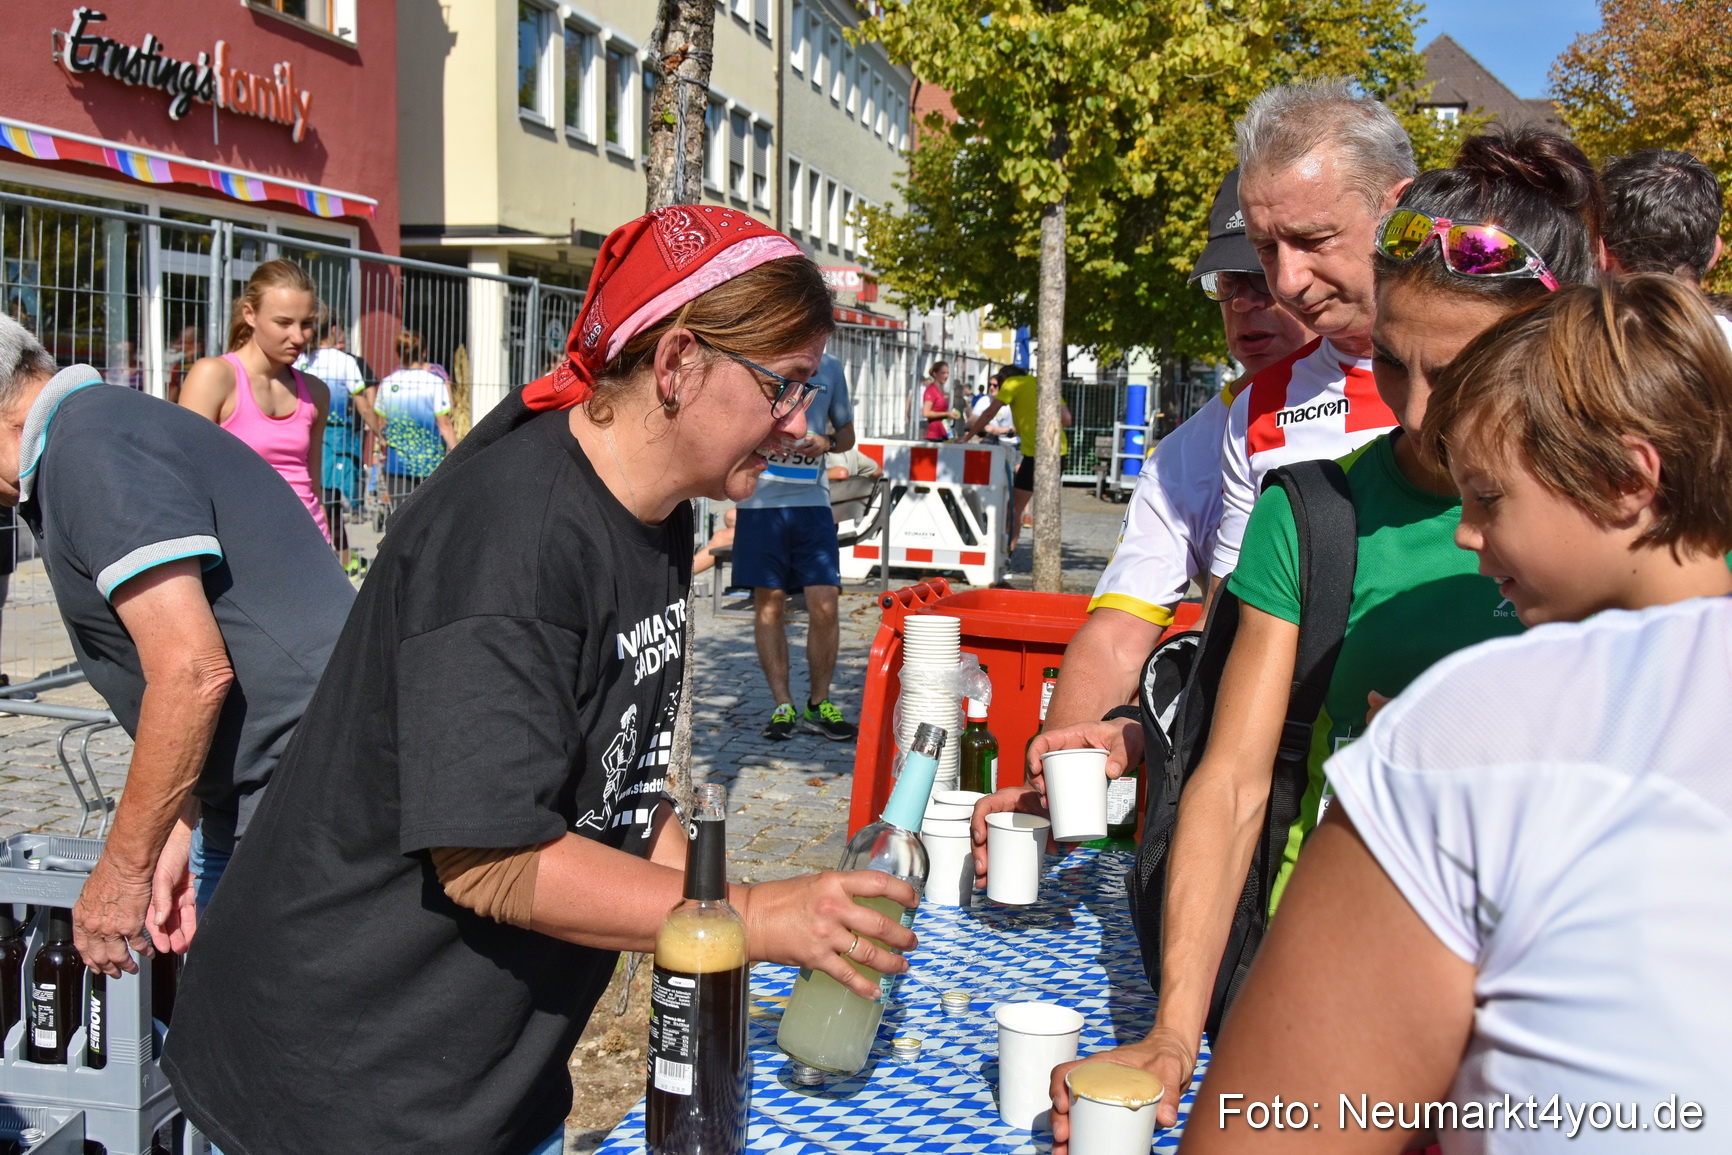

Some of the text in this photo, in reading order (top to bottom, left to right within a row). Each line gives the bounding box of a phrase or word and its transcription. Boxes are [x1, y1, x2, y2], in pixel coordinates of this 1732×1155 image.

[65, 7, 312, 143] Ernsting's family
[1276, 398, 1350, 427] macron
[1493, 609, 1508, 618] Die
